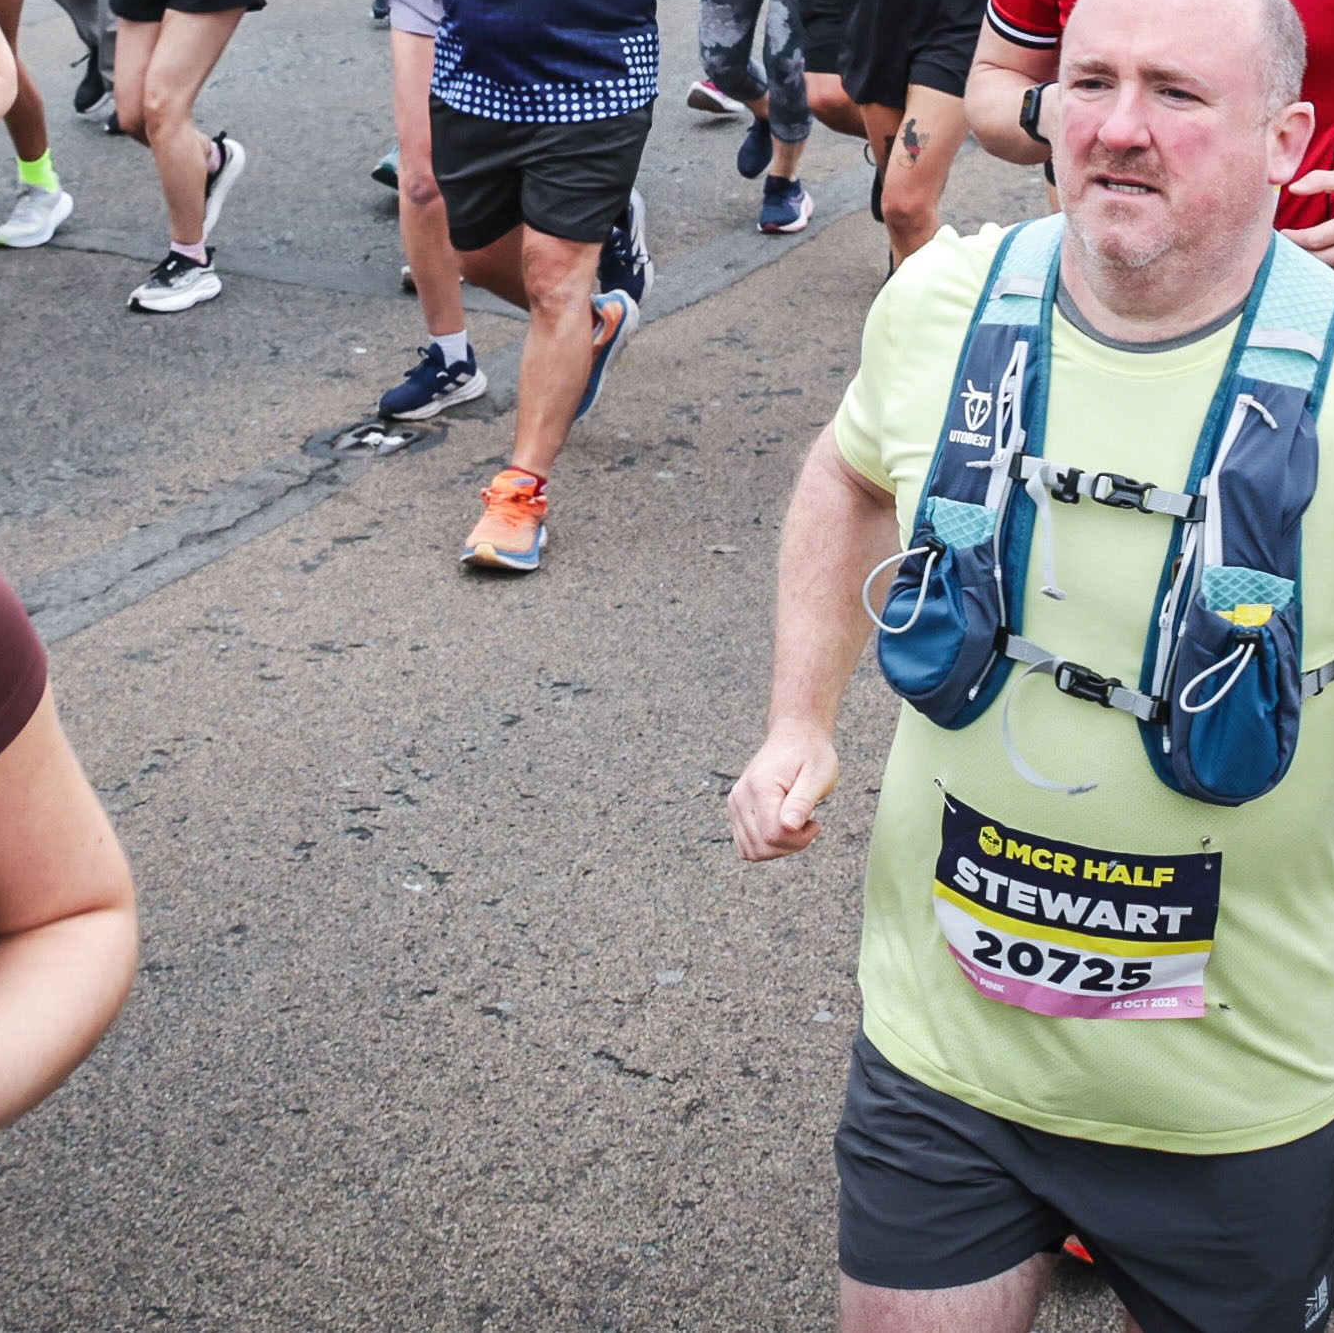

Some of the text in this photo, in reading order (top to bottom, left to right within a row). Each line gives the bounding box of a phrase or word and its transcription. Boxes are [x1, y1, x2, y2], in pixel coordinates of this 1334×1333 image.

[948, 429, 992, 448] UTOBEST
[1005, 838, 1175, 888] MCR HALF
[952, 856, 1193, 935] STEWART
[972, 930, 1153, 993] 20725
[979, 977, 1006, 994] PINK
[1111, 996, 1179, 1010] 12 OCT 2025
